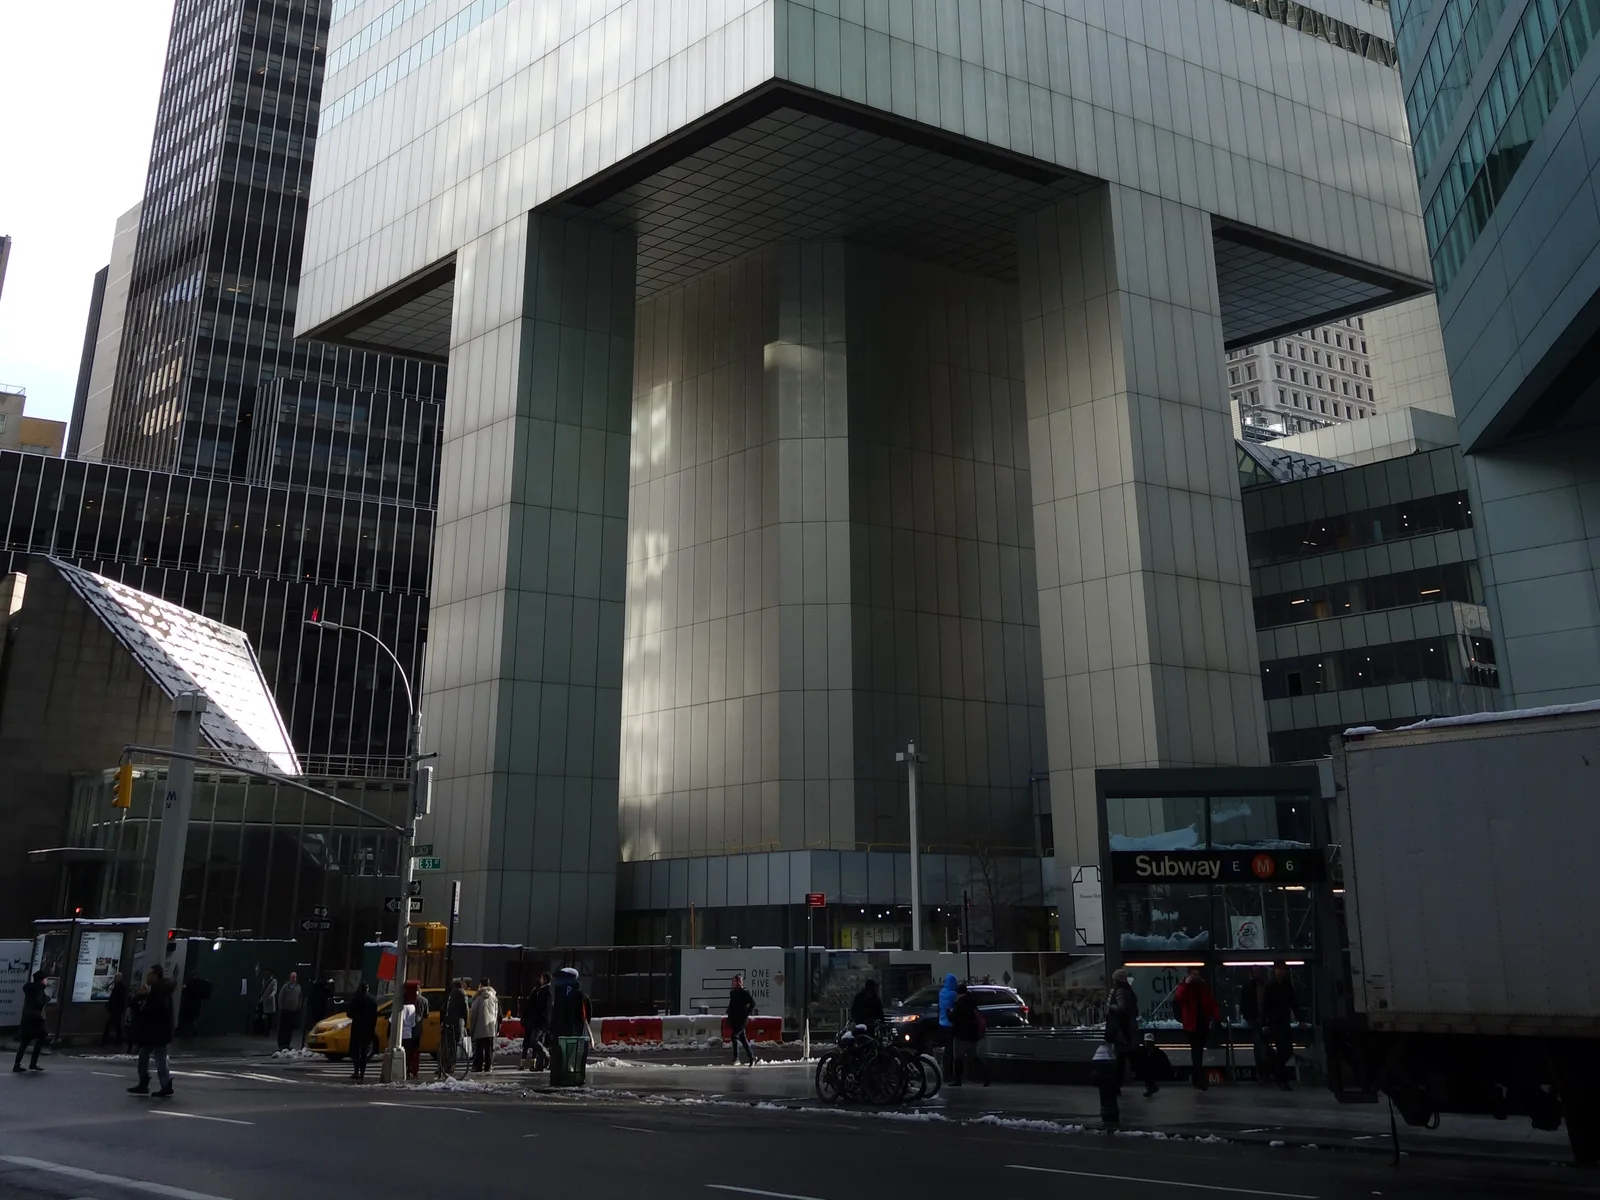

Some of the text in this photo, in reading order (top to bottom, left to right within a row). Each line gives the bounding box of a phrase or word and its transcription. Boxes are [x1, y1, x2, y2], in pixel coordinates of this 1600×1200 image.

[425, 860, 432, 868] 53
[1135, 854, 1293, 879] Subway E M 6
[752, 969, 770, 978] ONE
[752, 979, 770, 987] FIVE
[566, 986, 572, 996] P
[752, 990, 770, 998] NINE
